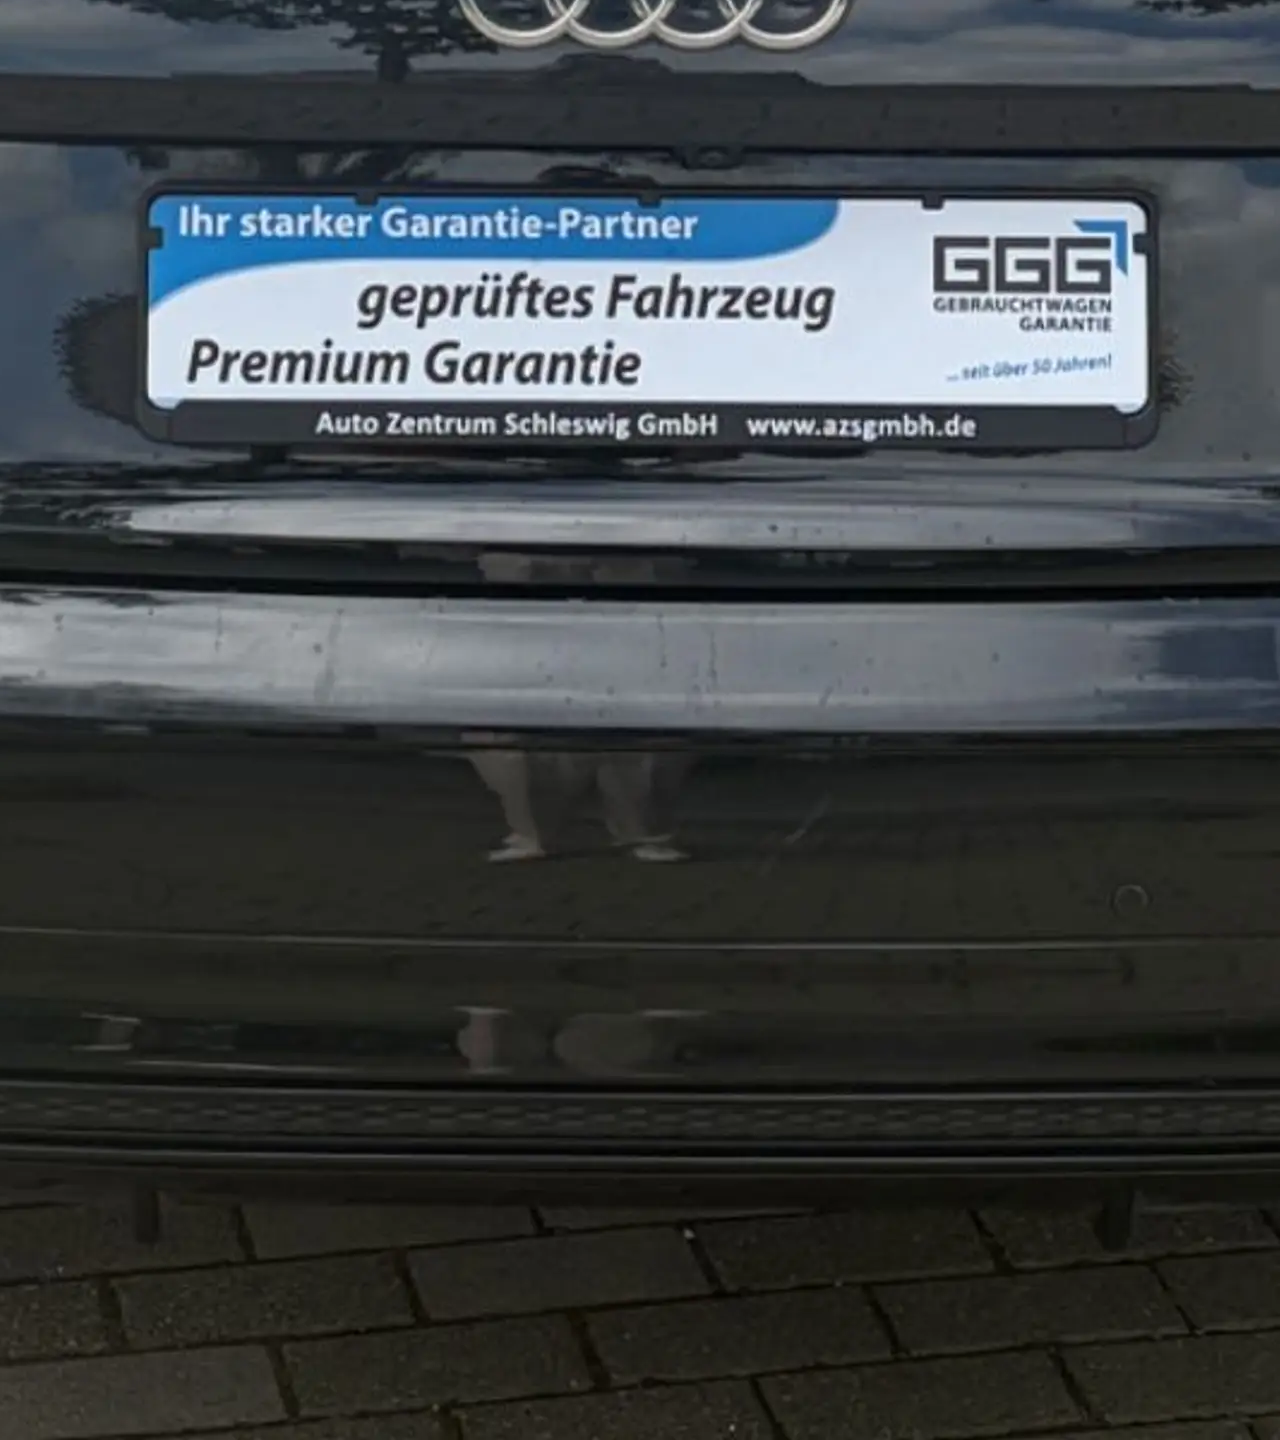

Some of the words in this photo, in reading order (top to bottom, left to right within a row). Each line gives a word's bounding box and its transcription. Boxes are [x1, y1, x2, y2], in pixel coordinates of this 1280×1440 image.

[178, 205, 231, 238] Ihr
[239, 206, 373, 239] starker
[380, 207, 699, 240] Garantie-Partner
[933, 236, 1112, 294] GGG
[356, 271, 595, 330] geprüftes
[604, 272, 836, 333] Fahrzeug
[932, 296, 1113, 314] GEBRAUCHTWAGEN
[1019, 316, 1113, 333] GARANTIE
[186, 339, 410, 385] Premium
[423, 339, 642, 387] Garantie
[992, 360, 1028, 378] über
[1032, 358, 1054, 376] 50
[1054, 353, 1113, 374] Jahren!
[315, 411, 379, 436] Auto
[384, 411, 497, 436] Zentrum
[503, 411, 631, 441] Schleswig
[637, 412, 718, 437] GmbH
[746, 413, 977, 442] www.azsgmbh.de
